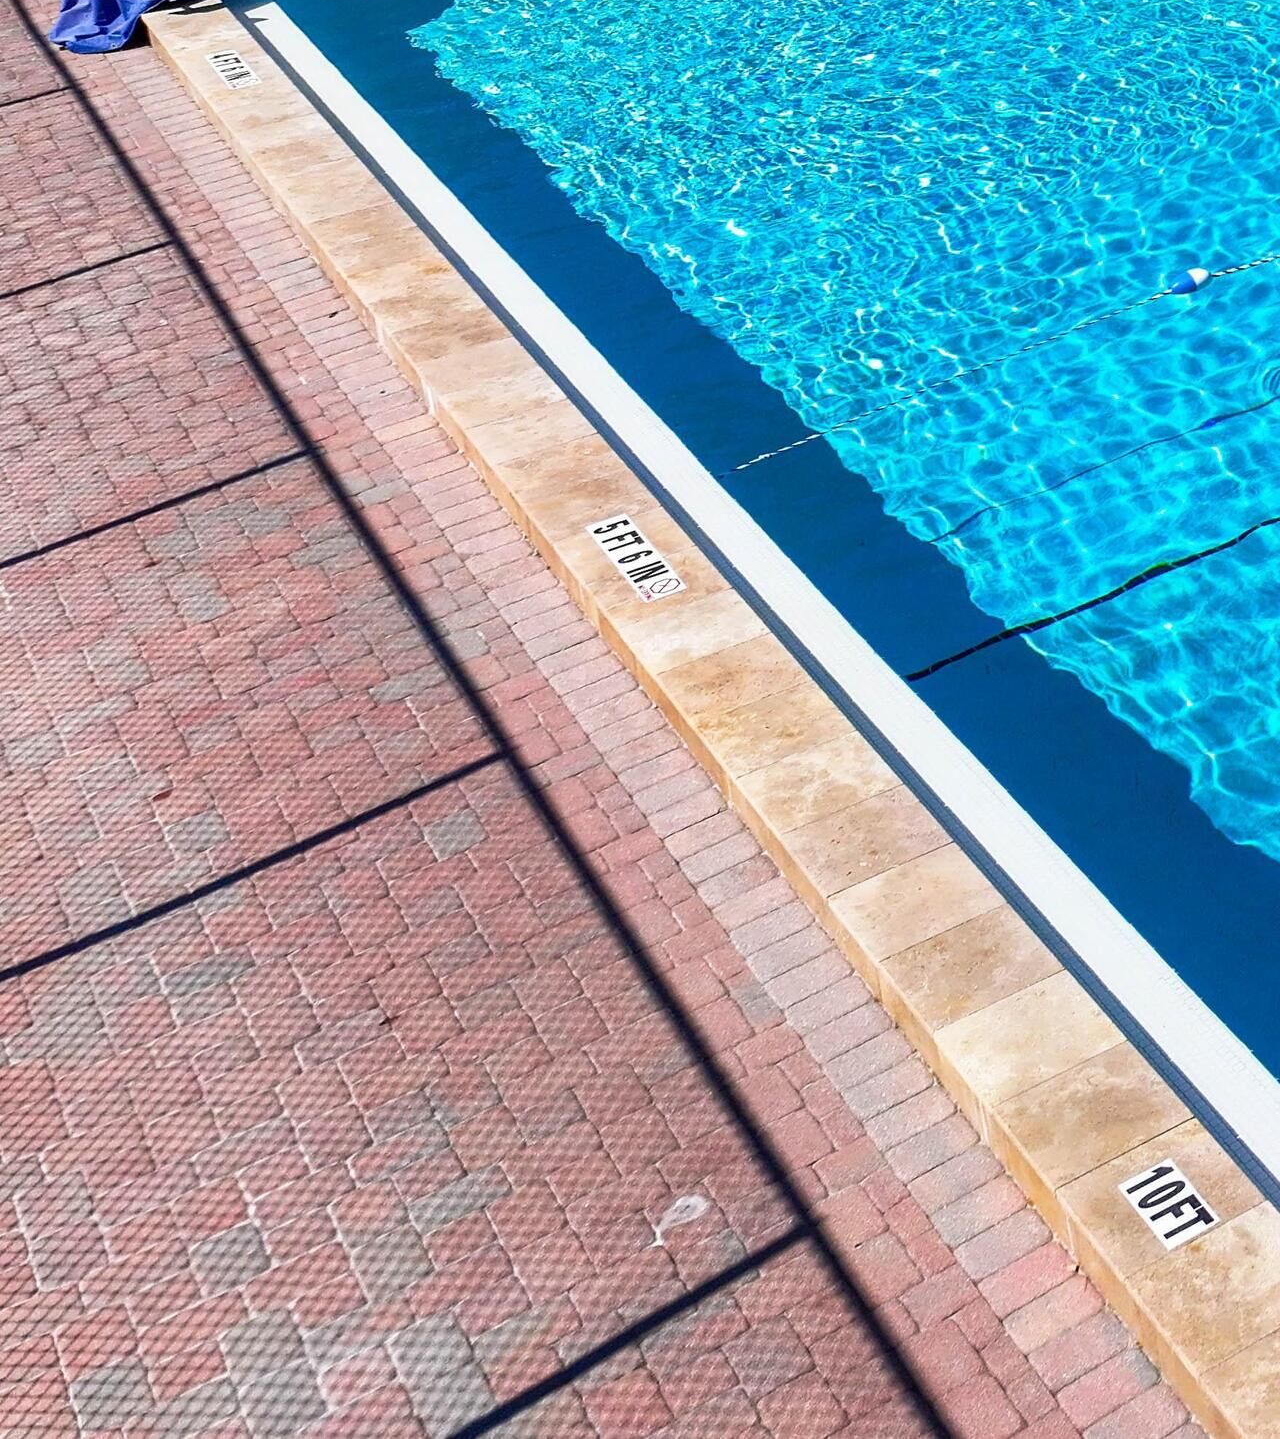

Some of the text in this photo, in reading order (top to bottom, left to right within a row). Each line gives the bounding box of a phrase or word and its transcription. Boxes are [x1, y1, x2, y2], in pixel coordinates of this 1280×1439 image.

[593, 519, 669, 583] 5 FT 6 IN
[1126, 1166, 1215, 1240] 10FT
